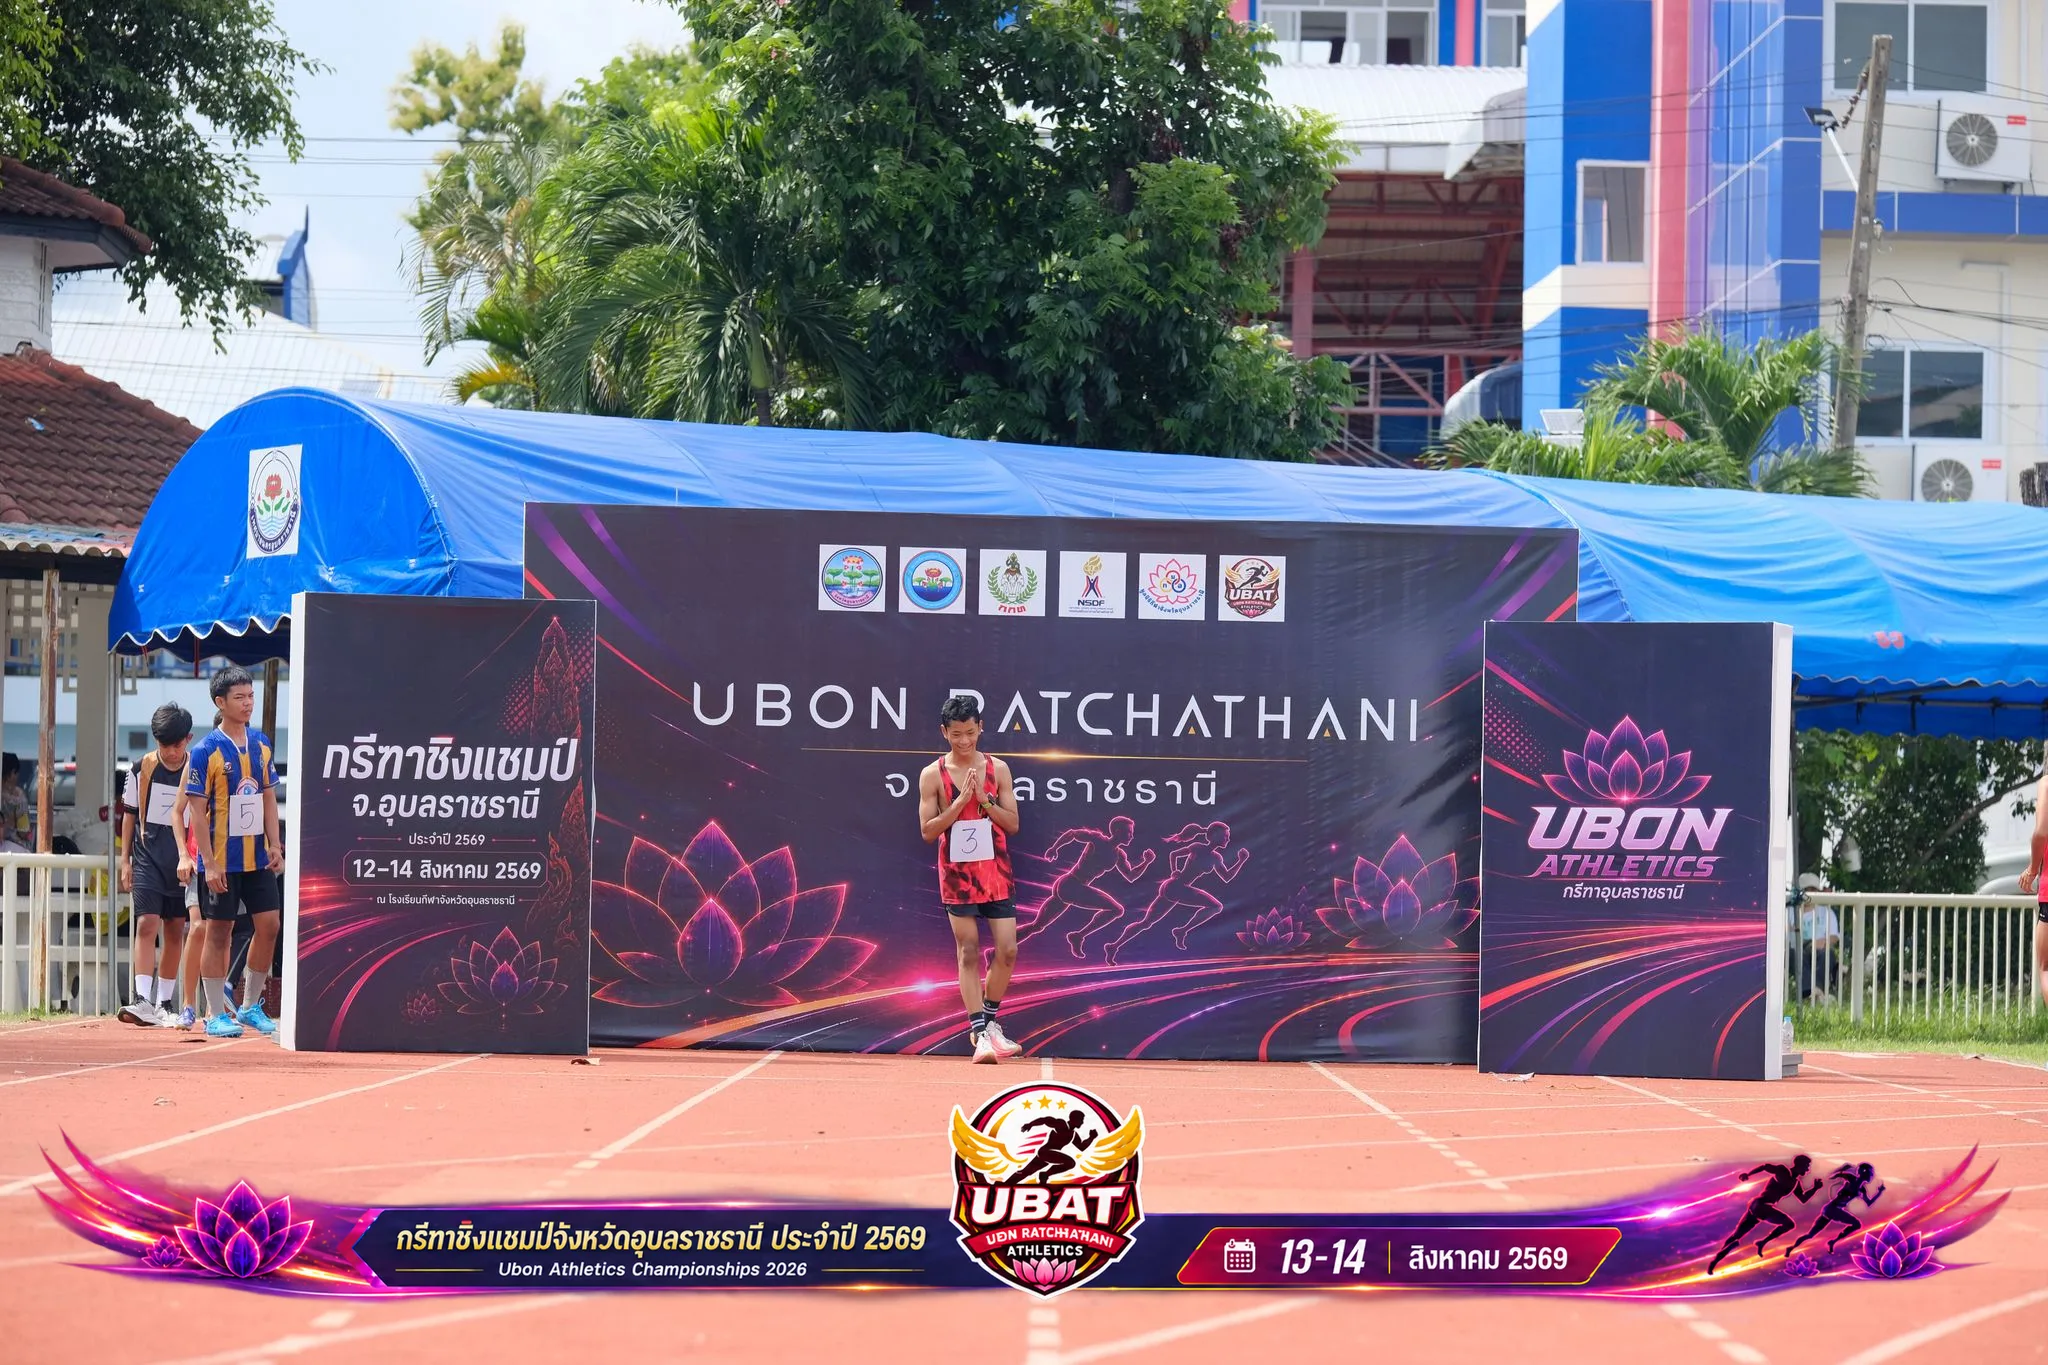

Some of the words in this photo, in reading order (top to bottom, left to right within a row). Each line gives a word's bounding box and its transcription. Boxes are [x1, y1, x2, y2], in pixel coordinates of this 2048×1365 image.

[1077, 599, 1105, 607] NSDF
[1229, 589, 1275, 601] UBAT
[998, 604, 1026, 614] กกท
[693, 681, 907, 730] UBON
[322, 733, 578, 782] กรีฑาชิงแชมป์
[240, 802, 255, 830] 5
[352, 788, 540, 827] จ.อุบลราชธานี
[408, 832, 451, 846] ประจำปี
[455, 834, 486, 846] 2569
[1527, 806, 1734, 851] UBON
[961, 828, 978, 854] 3
[419, 859, 488, 879] สิงหาคม
[495, 862, 542, 880] 2569
[1524, 854, 1726, 878] ATHLETICS
[376, 896, 386, 905] ณ
[1562, 884, 1685, 903] กรีฑาอุบลราชธานี
